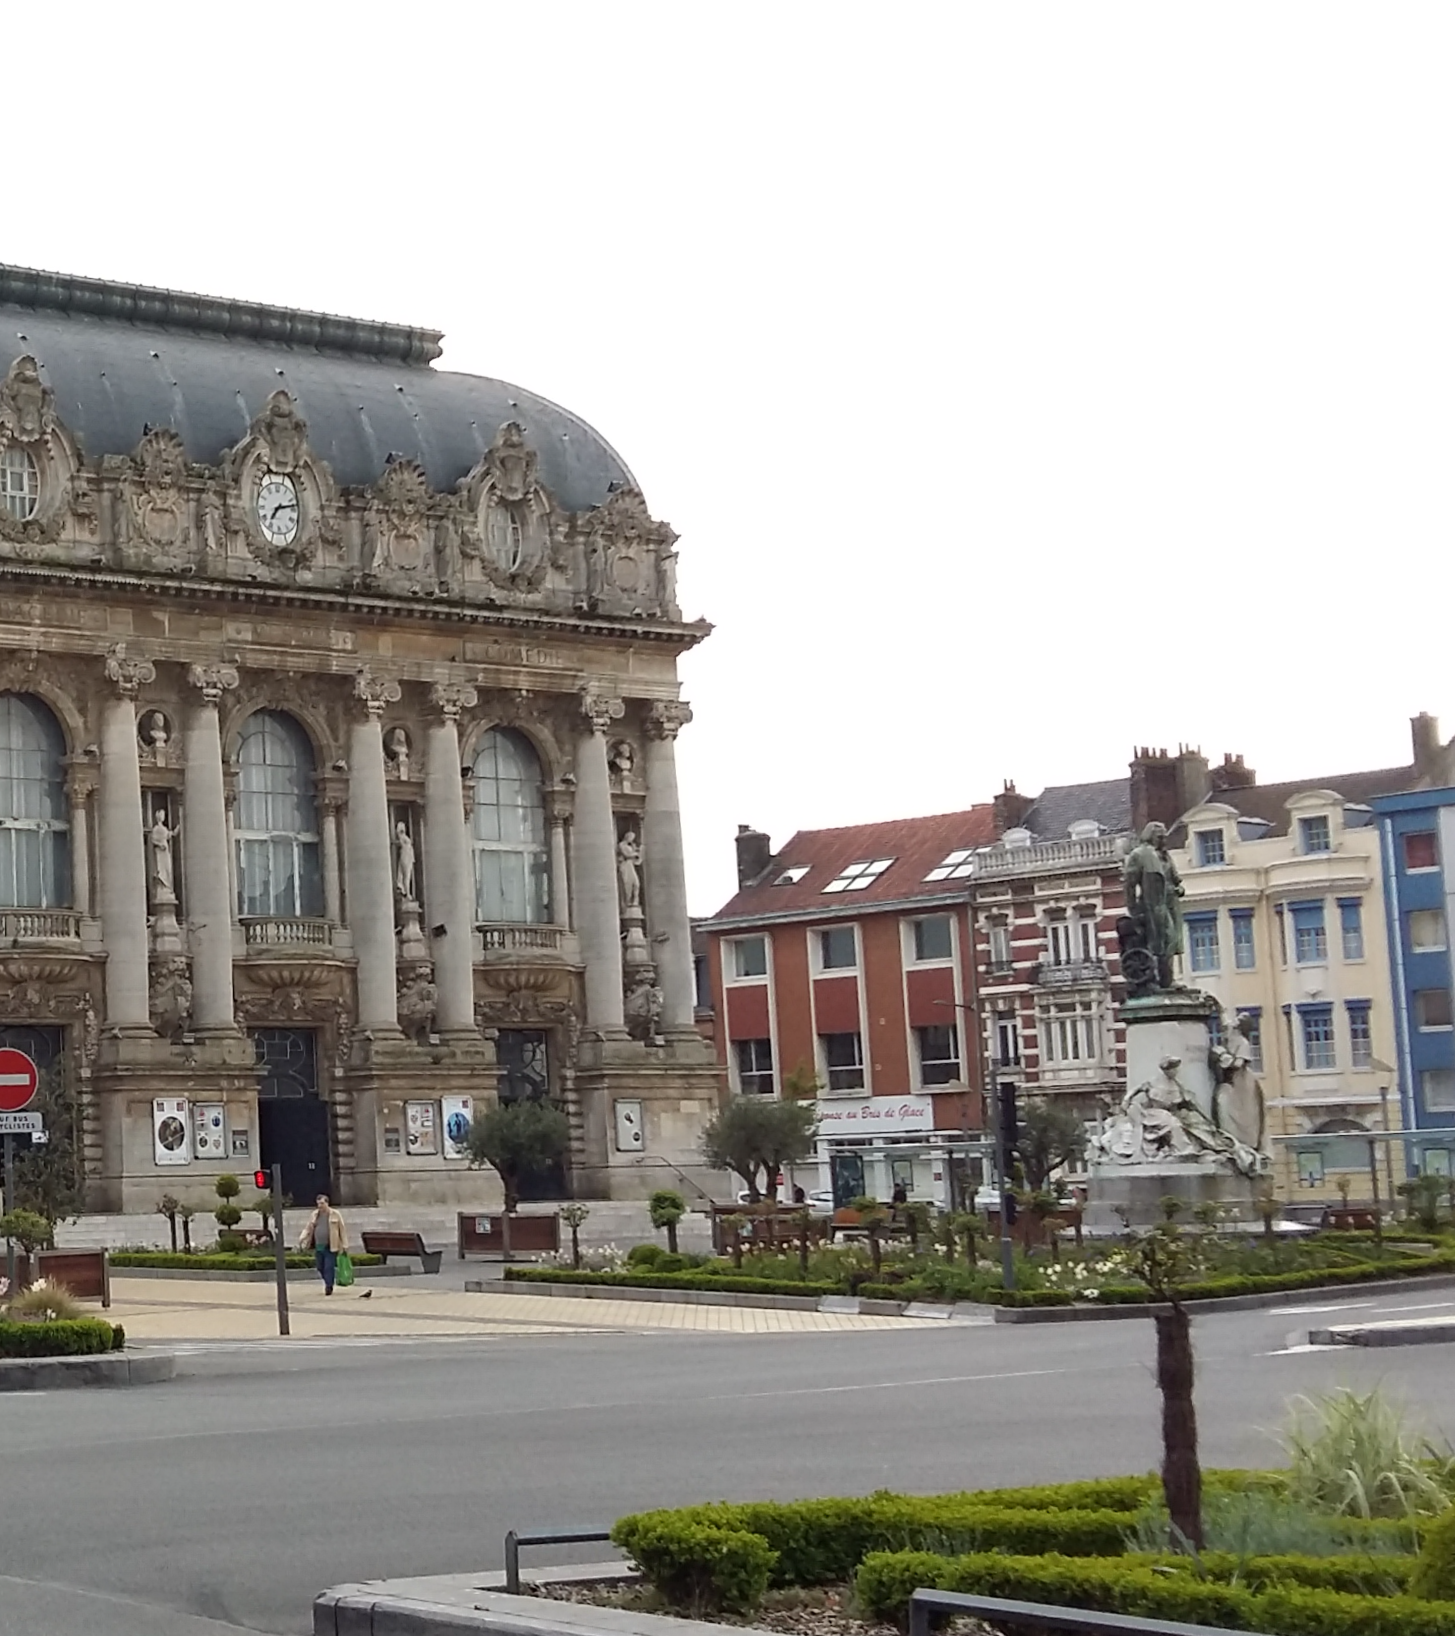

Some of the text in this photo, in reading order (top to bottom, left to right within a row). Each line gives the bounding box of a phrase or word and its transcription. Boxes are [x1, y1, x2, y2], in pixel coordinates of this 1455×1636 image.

[861, 1105, 881, 1119] Bris
[884, 1107, 895, 1118] de
[898, 1104, 925, 1121] Glace
